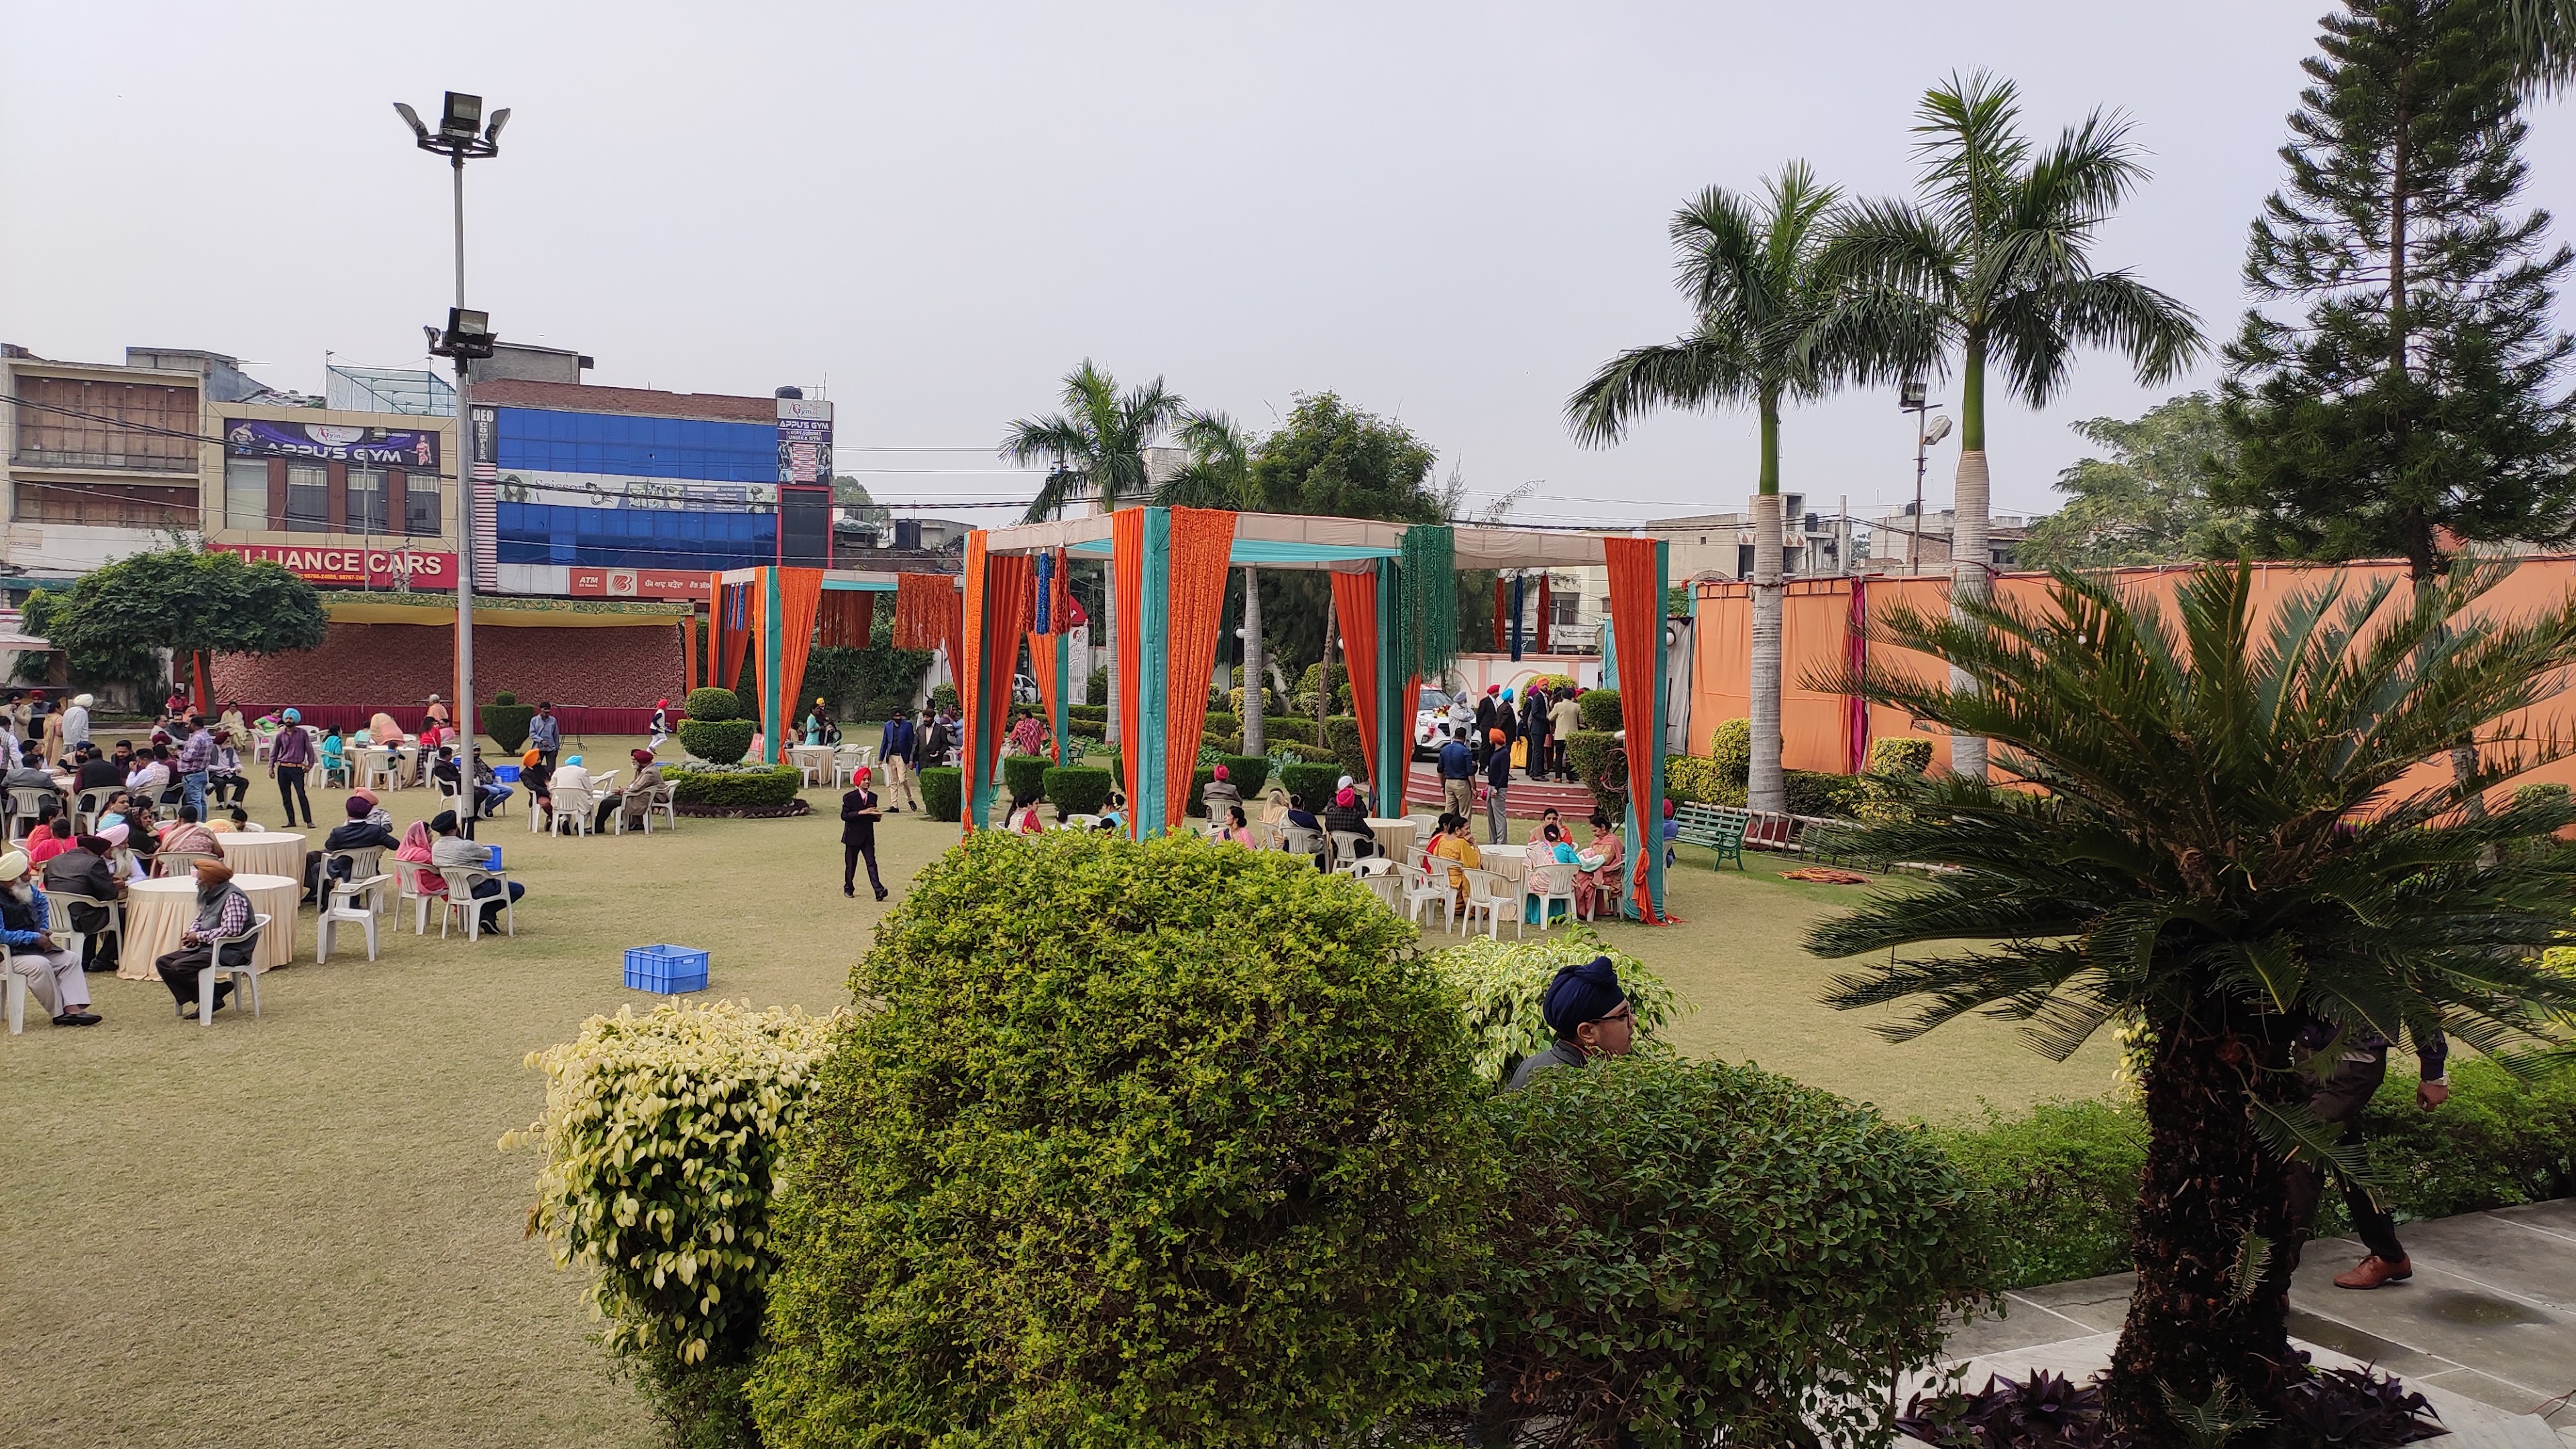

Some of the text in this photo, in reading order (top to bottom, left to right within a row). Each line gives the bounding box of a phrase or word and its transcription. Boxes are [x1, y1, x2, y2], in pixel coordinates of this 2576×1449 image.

[473, 409, 494, 422] DEO
[780, 421, 810, 429] APPU'S
[263, 442, 402, 462] APPU'S GYM
[230, 548, 442, 575] LIANCE CARS
